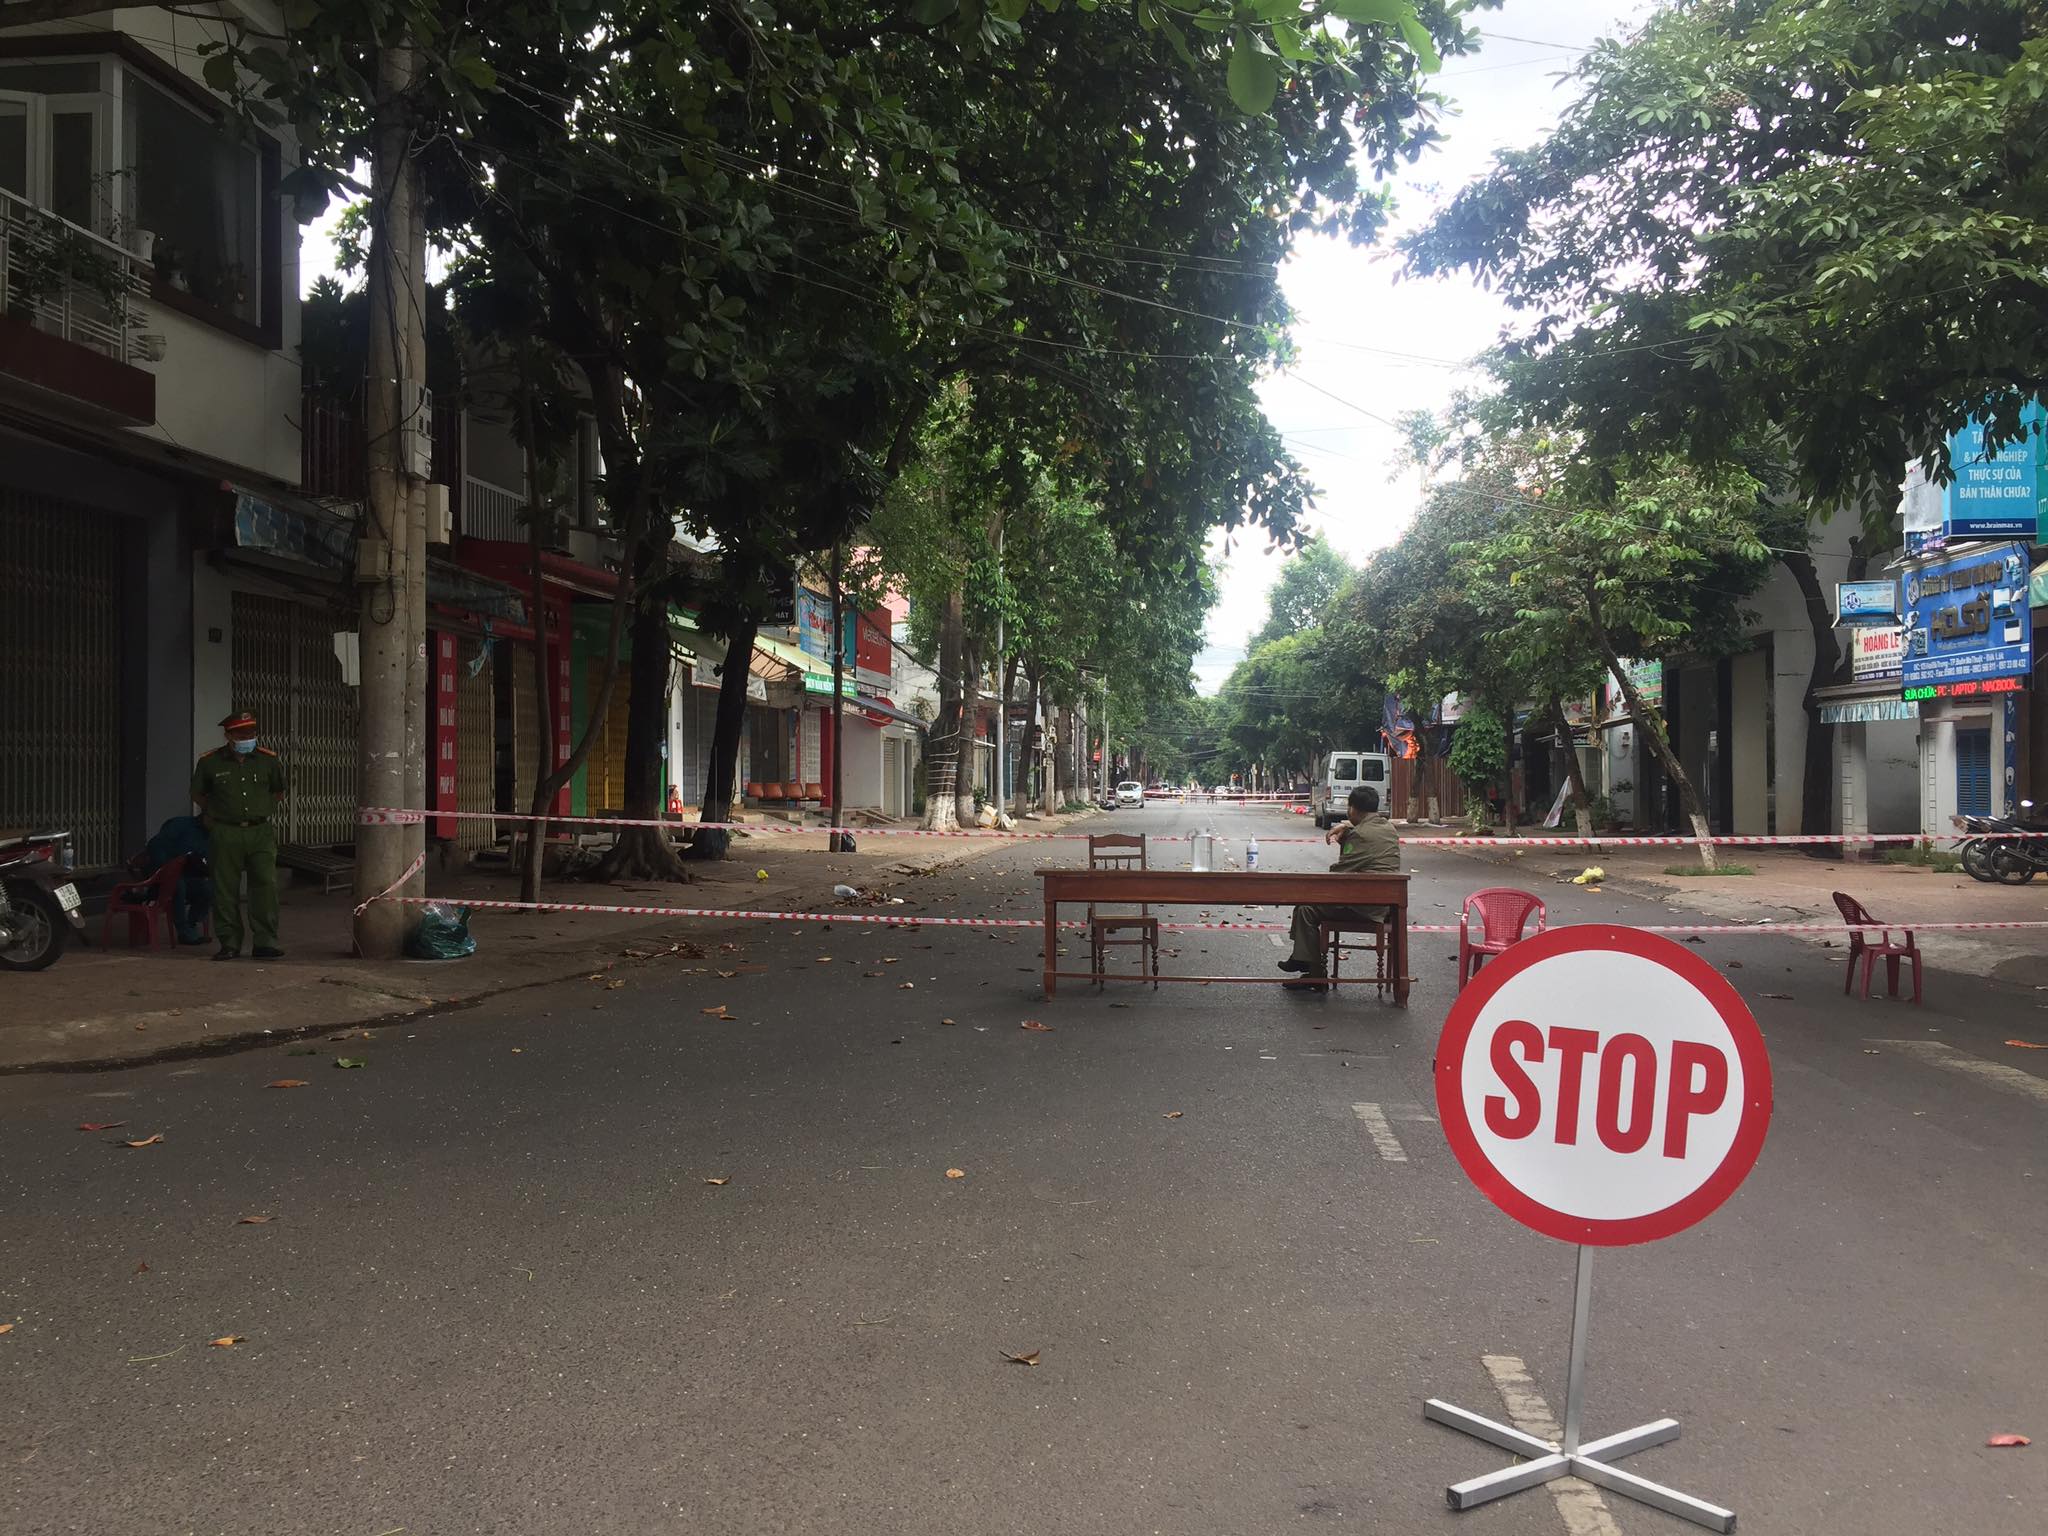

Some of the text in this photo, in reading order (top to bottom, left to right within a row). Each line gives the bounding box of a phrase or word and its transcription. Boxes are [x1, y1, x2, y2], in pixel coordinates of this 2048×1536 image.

[1969, 466, 2022, 483] THỰC SỰ CỦA
[2003, 485, 2031, 499] CHƯA?
[1864, 632, 1888, 652] HOÀNG
[1951, 682, 1978, 696] LAPTOP
[1484, 1020, 1728, 1159] STOP
